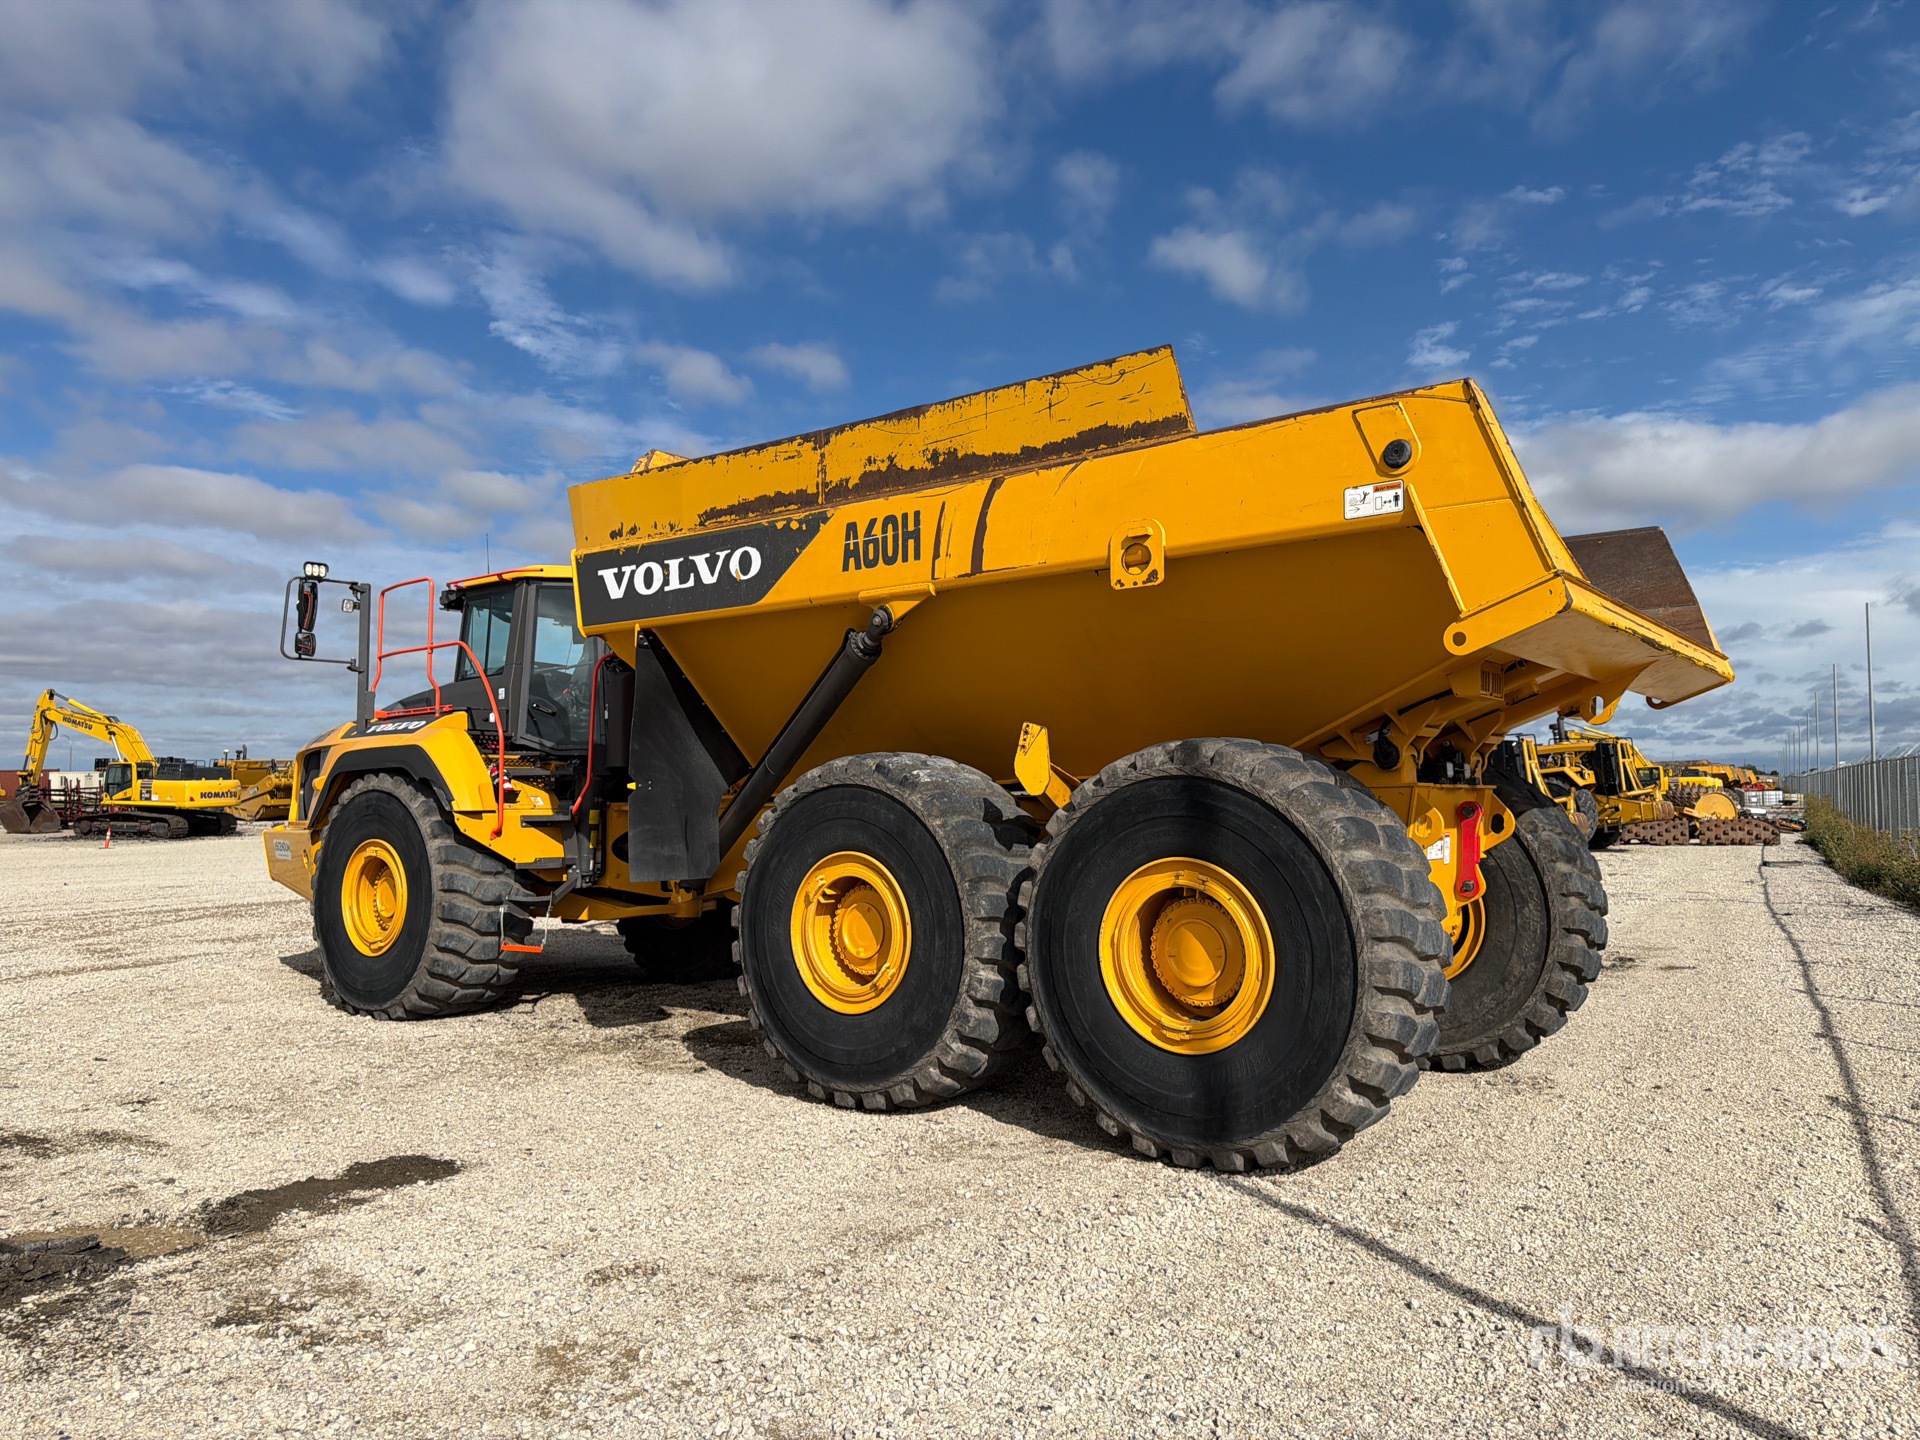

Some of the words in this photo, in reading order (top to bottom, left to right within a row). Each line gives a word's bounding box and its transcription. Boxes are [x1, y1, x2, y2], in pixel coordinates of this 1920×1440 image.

[842, 510, 922, 573] A60H
[597, 546, 762, 600] VOLVO
[62, 715, 93, 730] KOMATSU
[366, 720, 427, 733] VOLVO
[200, 790, 237, 799] KOMATSU
